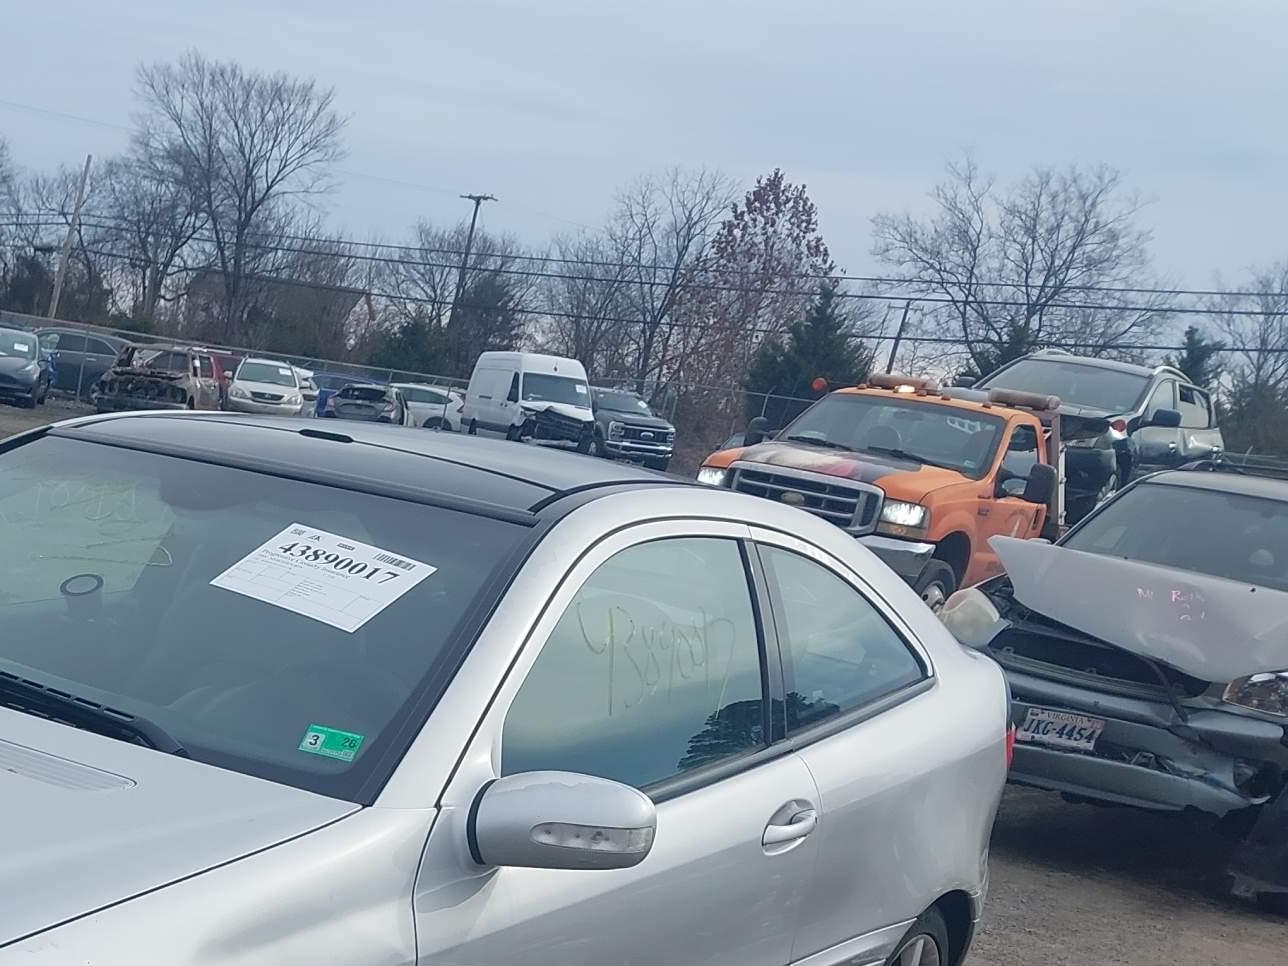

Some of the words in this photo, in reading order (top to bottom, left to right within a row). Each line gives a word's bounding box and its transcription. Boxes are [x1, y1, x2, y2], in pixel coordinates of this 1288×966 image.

[279, 541, 400, 584] 43890017
[1047, 712, 1084, 724] VIRGINIA
[308, 734, 320, 746] 3
